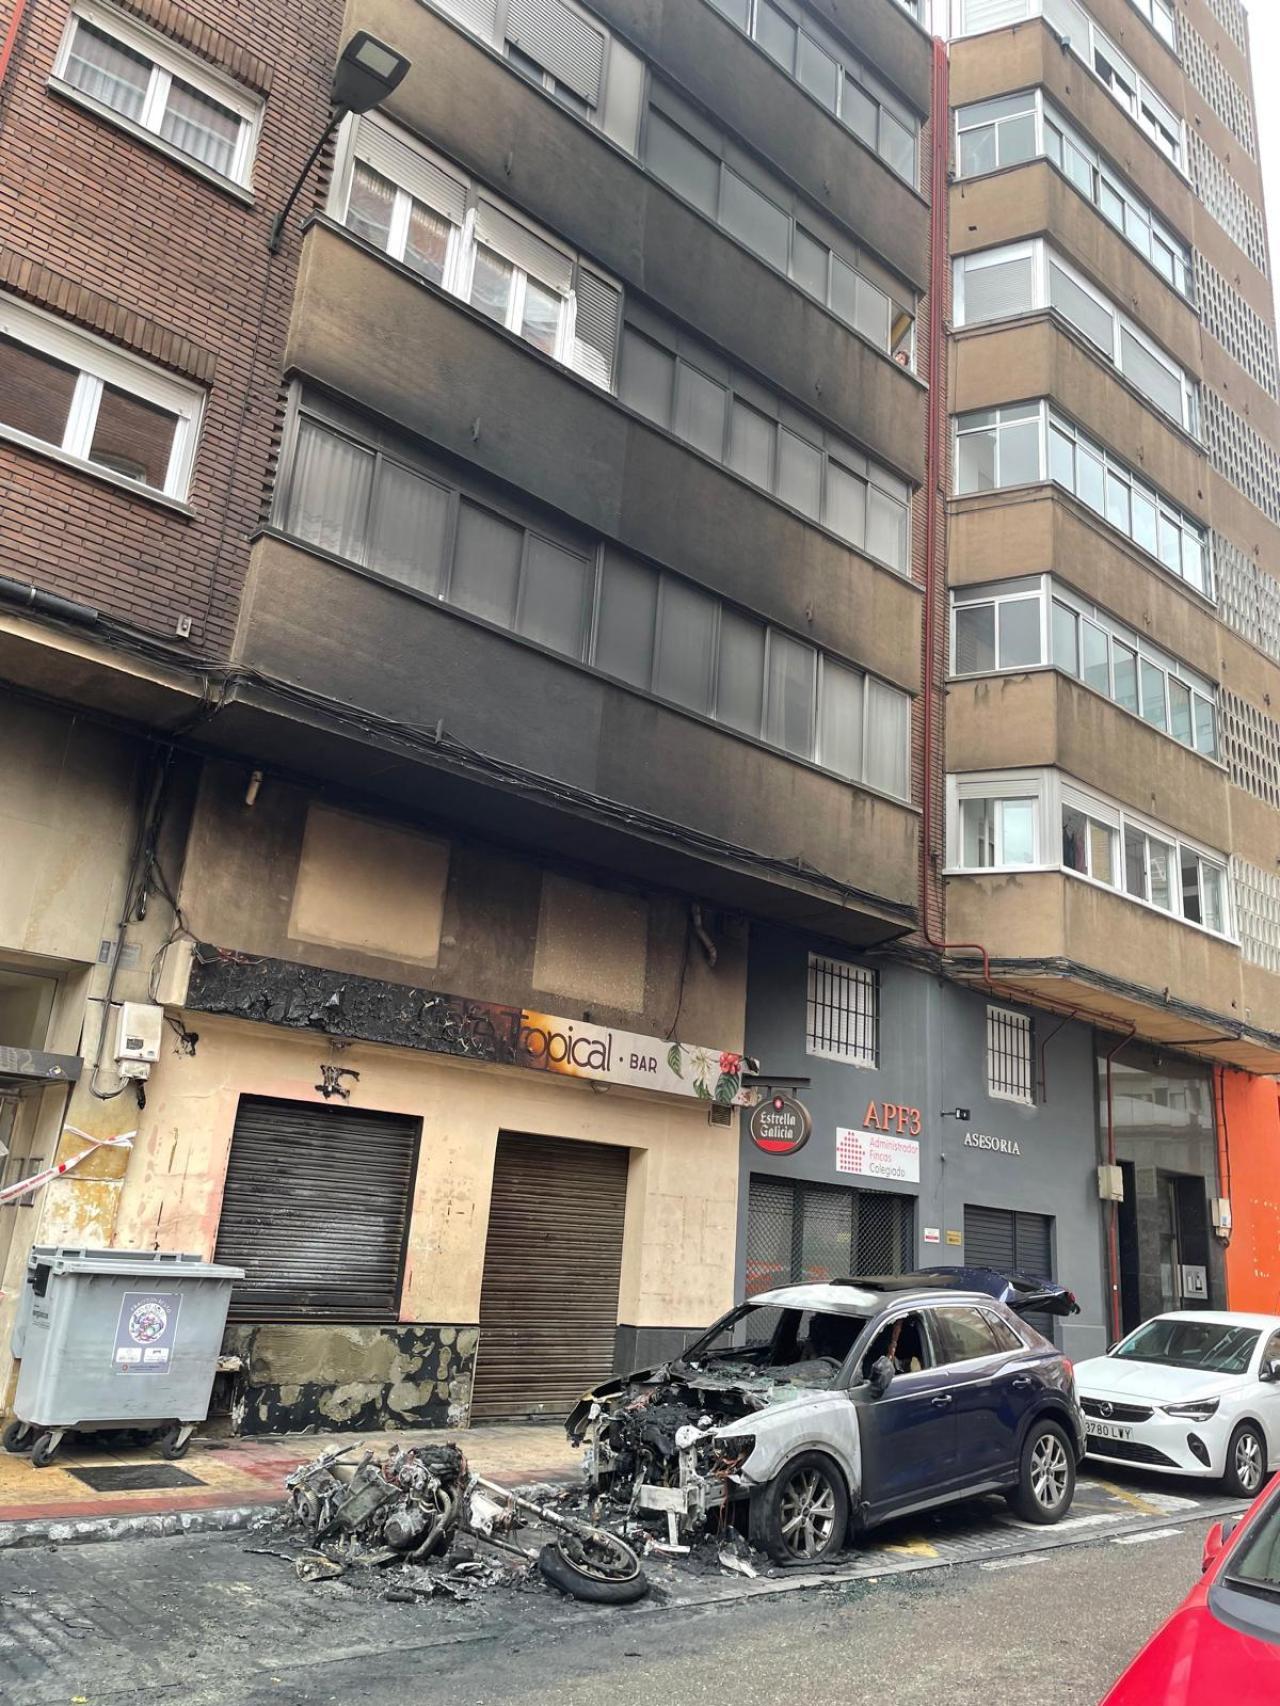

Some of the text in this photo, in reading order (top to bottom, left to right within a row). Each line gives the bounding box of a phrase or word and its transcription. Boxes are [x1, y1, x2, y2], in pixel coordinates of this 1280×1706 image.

[629, 1053, 657, 1073] BAR
[760, 1111, 796, 1126] Estrella
[863, 1100, 921, 1136] APF3
[760, 1124, 794, 1139] Galicia
[869, 1136, 919, 1154] Administrador
[964, 1132, 1021, 1156] ASESORIA
[869, 1149, 892, 1163] Fincas
[869, 1162, 906, 1178] Colegiado
